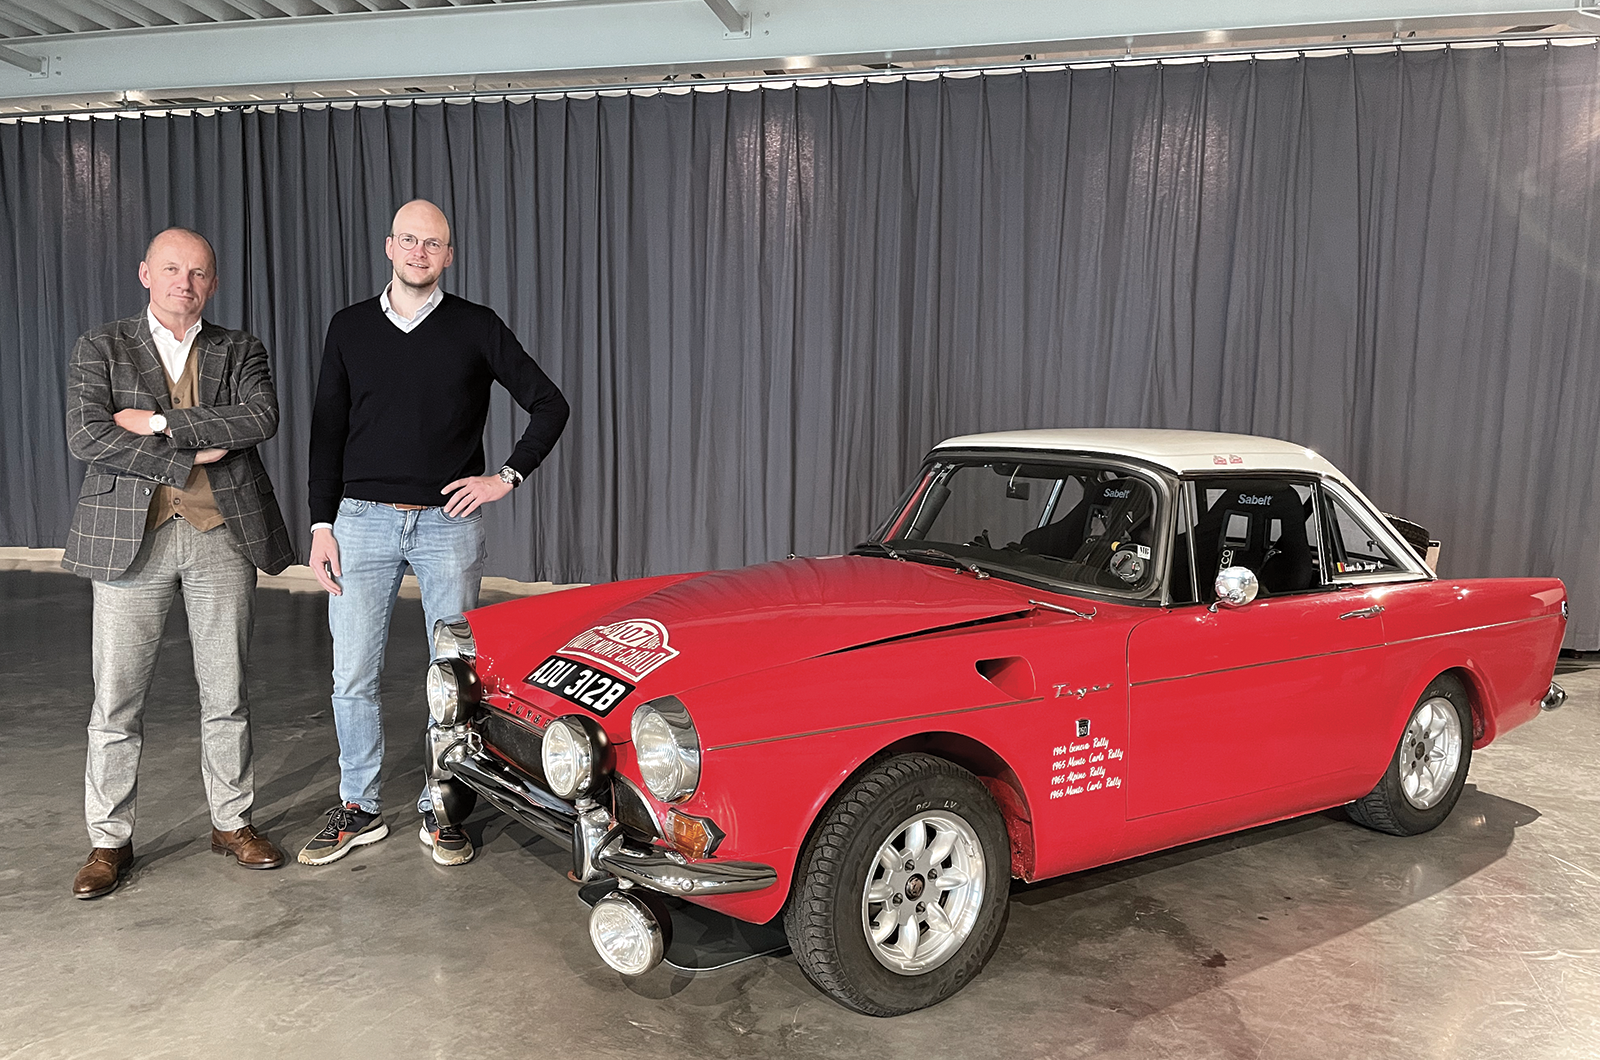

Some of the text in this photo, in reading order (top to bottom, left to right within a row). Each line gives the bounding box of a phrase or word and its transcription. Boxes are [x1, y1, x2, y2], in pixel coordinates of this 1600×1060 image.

[1103, 488, 1130, 499] Sabelt
[1238, 494, 1272, 506] Sabelt
[612, 624, 655, 643] 107
[528, 658, 626, 711] ADU 312B
[1053, 737, 1109, 756] 1964 Geneva Rally
[1052, 748, 1124, 771] 1965 Monte Carlo Rally
[1051, 766, 1106, 785] 1965 Alpine Rally
[1050, 776, 1122, 800] 1966 Monte Carlo Rally
